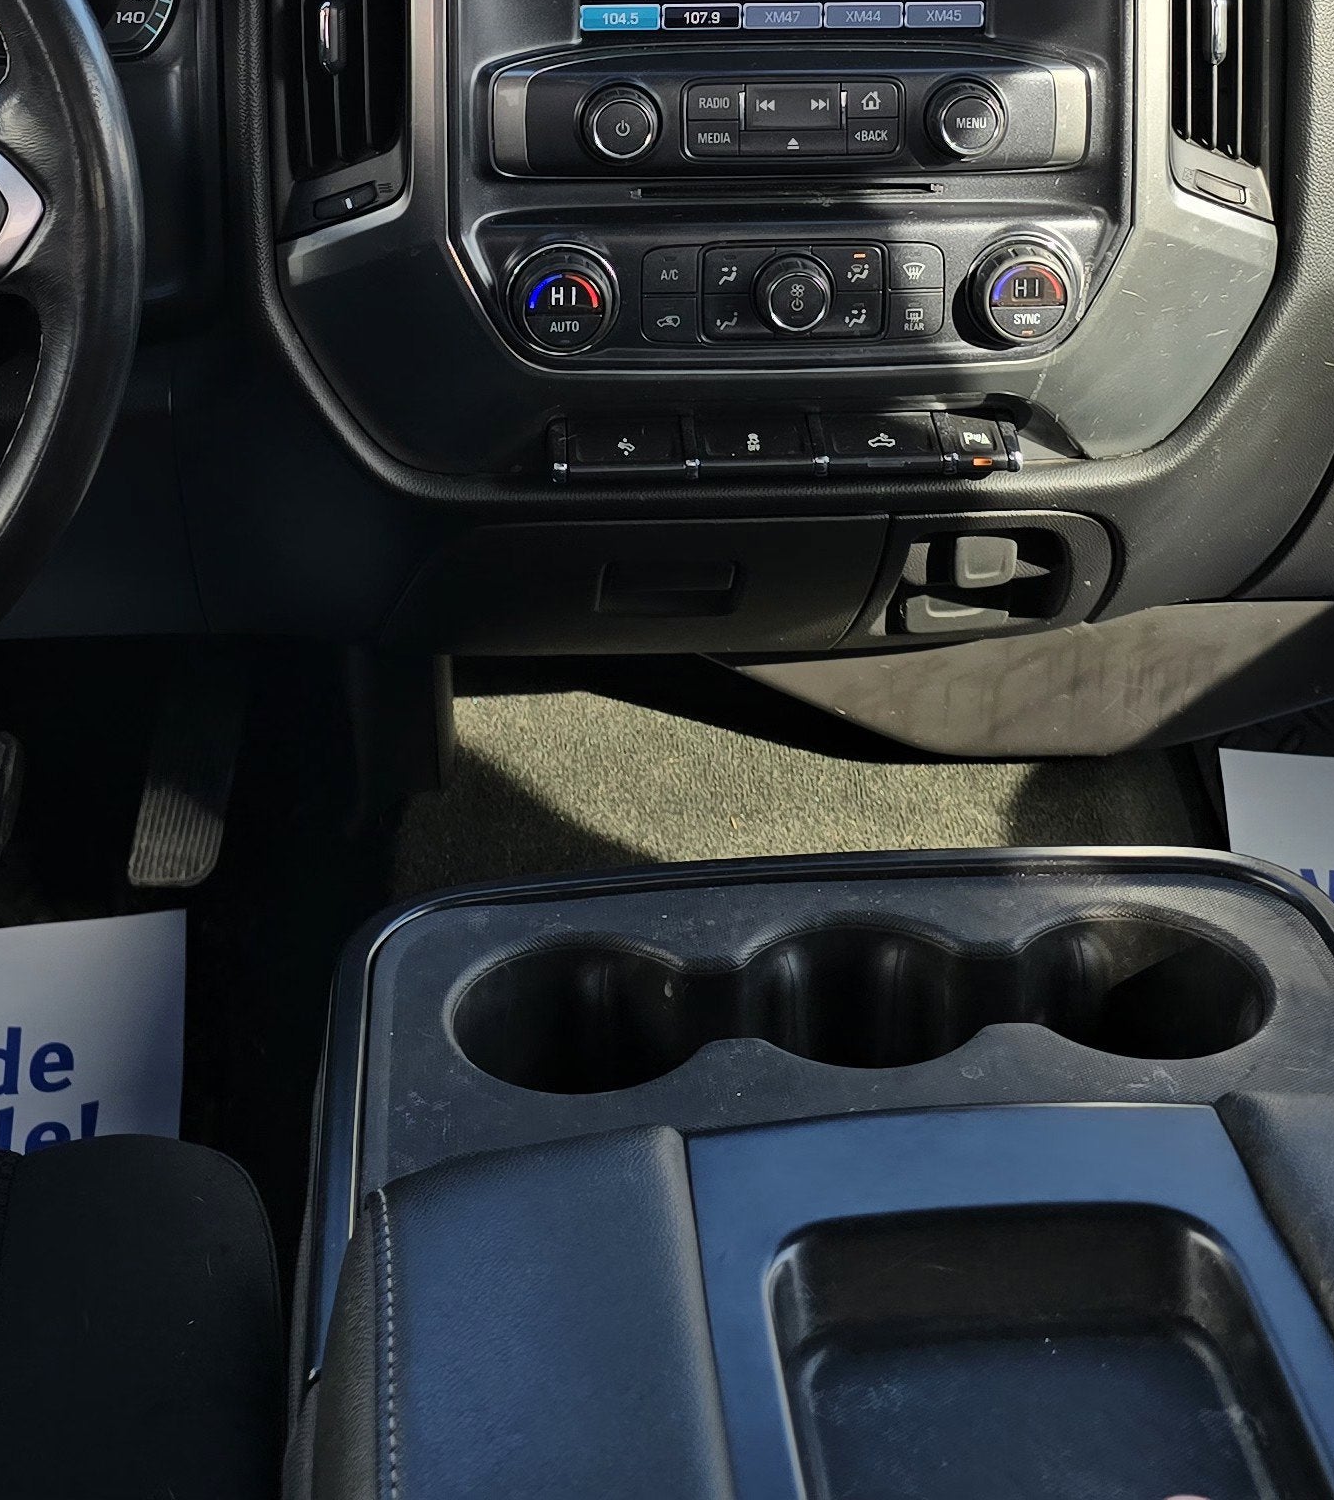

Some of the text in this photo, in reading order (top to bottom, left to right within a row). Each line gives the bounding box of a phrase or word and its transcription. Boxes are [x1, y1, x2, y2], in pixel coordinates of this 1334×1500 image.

[116, 11, 146, 24] 140
[602, 12, 640, 26] 104.5
[683, 11, 721, 25] 107.9
[764, 11, 801, 23] XM47
[845, 10, 882, 23] XM44
[926, 9, 963, 23] XM45
[698, 96, 730, 110] RADIO
[955, 116, 988, 130] MENU
[697, 131, 731, 145] MEDIA
[861, 128, 889, 142] BACK
[660, 268, 679, 281] A/C
[1014, 278, 1040, 298] HI
[551, 286, 577, 306] HI
[1013, 313, 1041, 325] SYNC
[549, 320, 580, 333] AUTO
[904, 322, 925, 331] REAR
